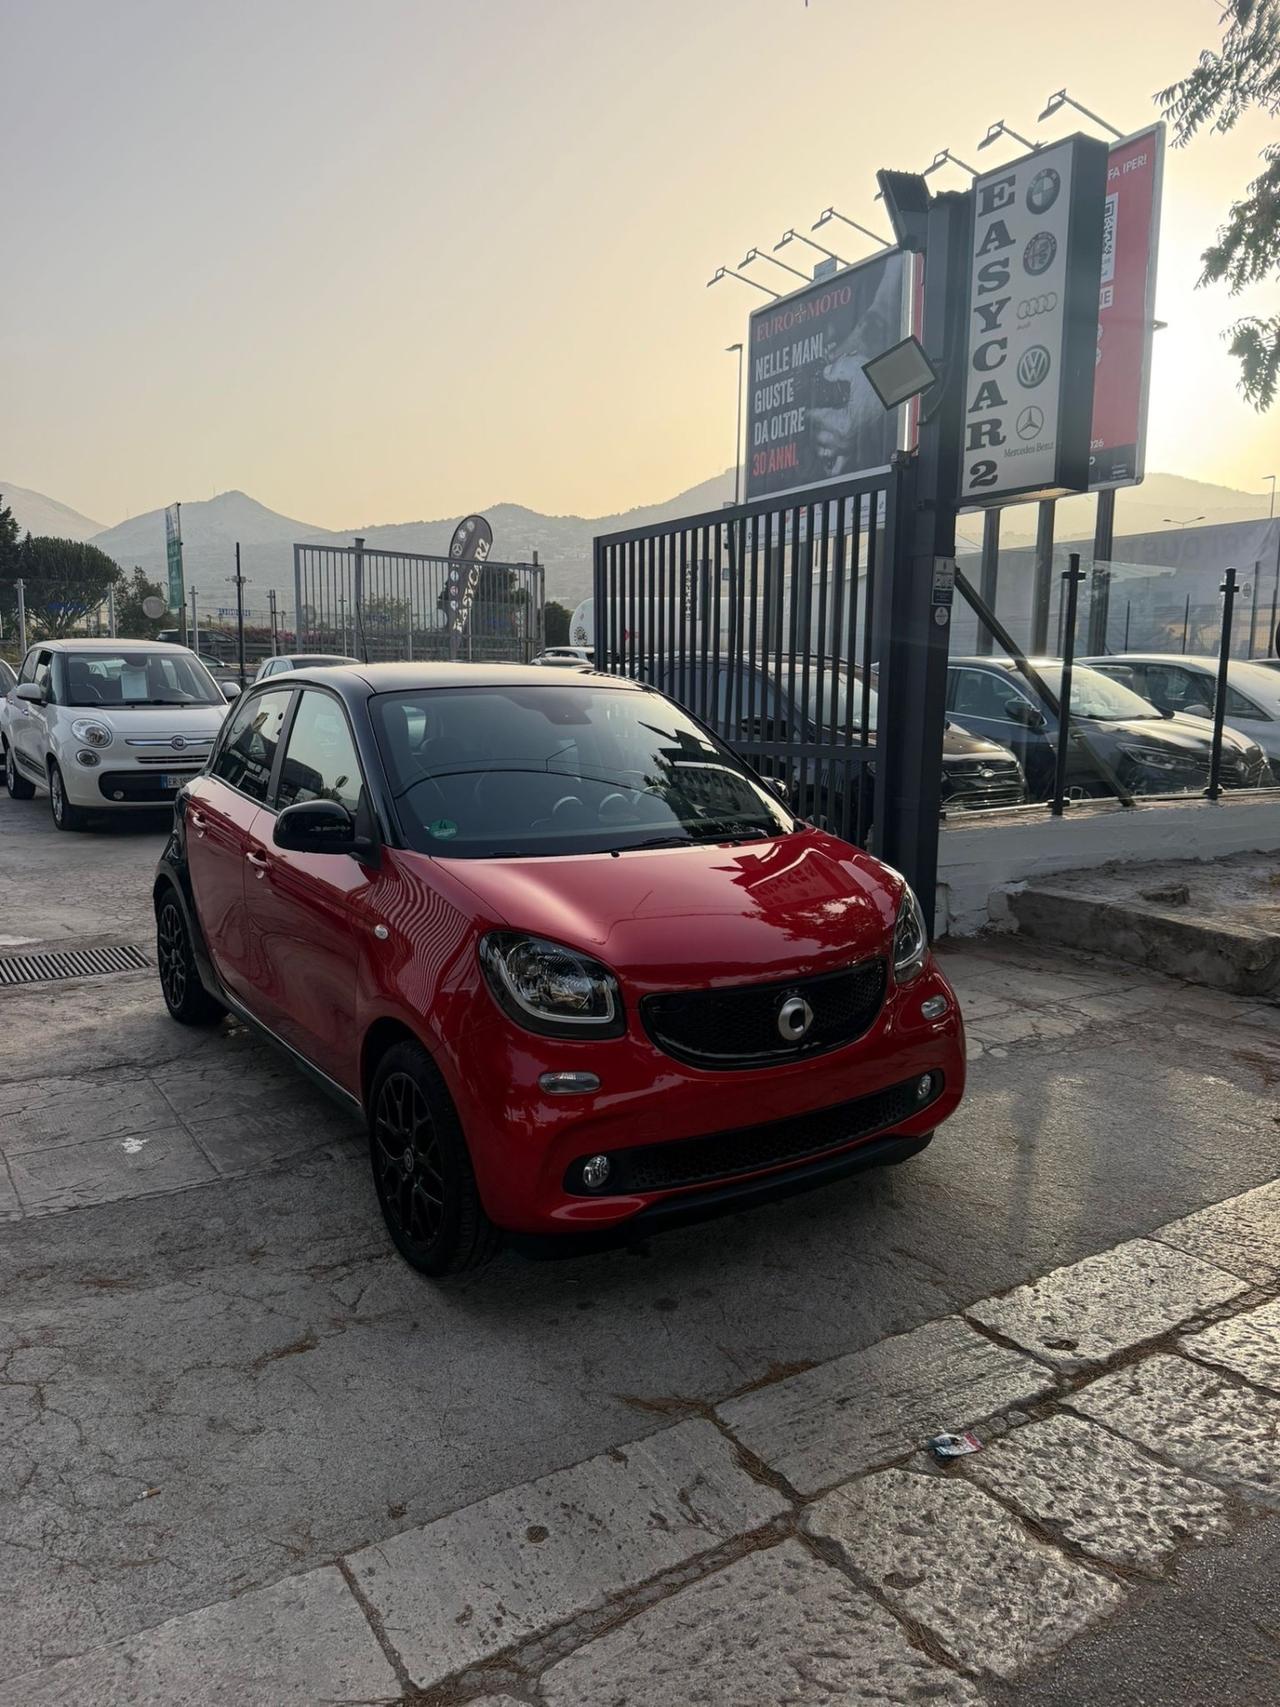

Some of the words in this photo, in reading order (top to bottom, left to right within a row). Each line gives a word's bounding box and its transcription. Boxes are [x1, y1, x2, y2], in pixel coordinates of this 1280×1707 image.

[755, 346, 790, 382] NELLE
[754, 377, 795, 415] GIUSTE
[754, 418, 769, 446] DA
[771, 406, 806, 441] OLTRE
[752, 451, 767, 477] 30
